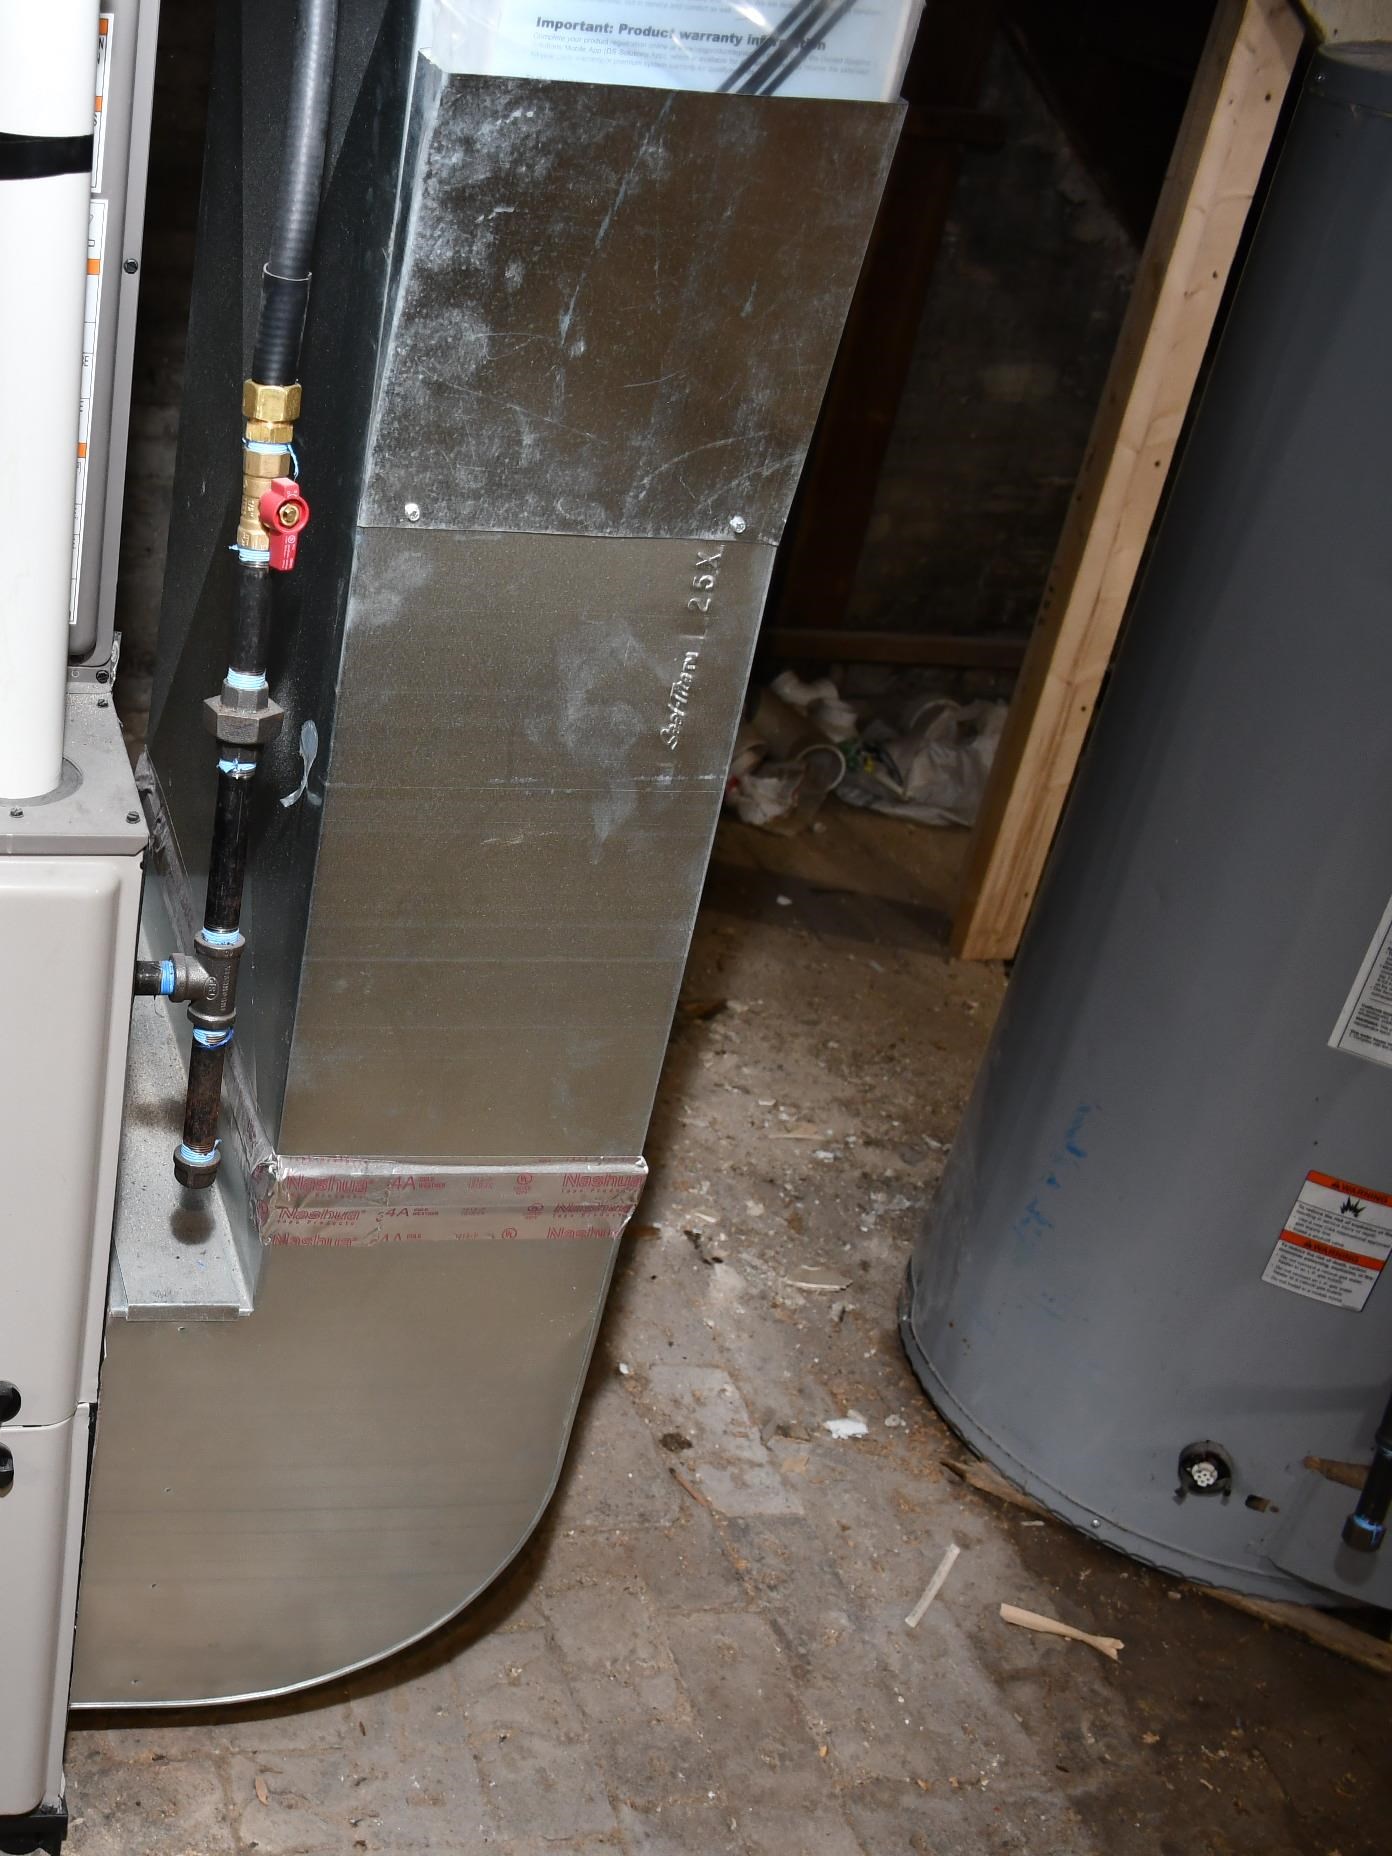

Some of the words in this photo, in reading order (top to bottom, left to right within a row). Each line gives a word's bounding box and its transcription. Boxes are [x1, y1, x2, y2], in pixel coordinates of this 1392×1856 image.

[536, 17, 614, 34] Important:
[619, 23, 674, 39] Product
[679, 30, 742, 46] warranty
[287, 1176, 368, 1193] Nashua
[563, 1173, 644, 1188] Nashua
[278, 1207, 360, 1221] Nashua
